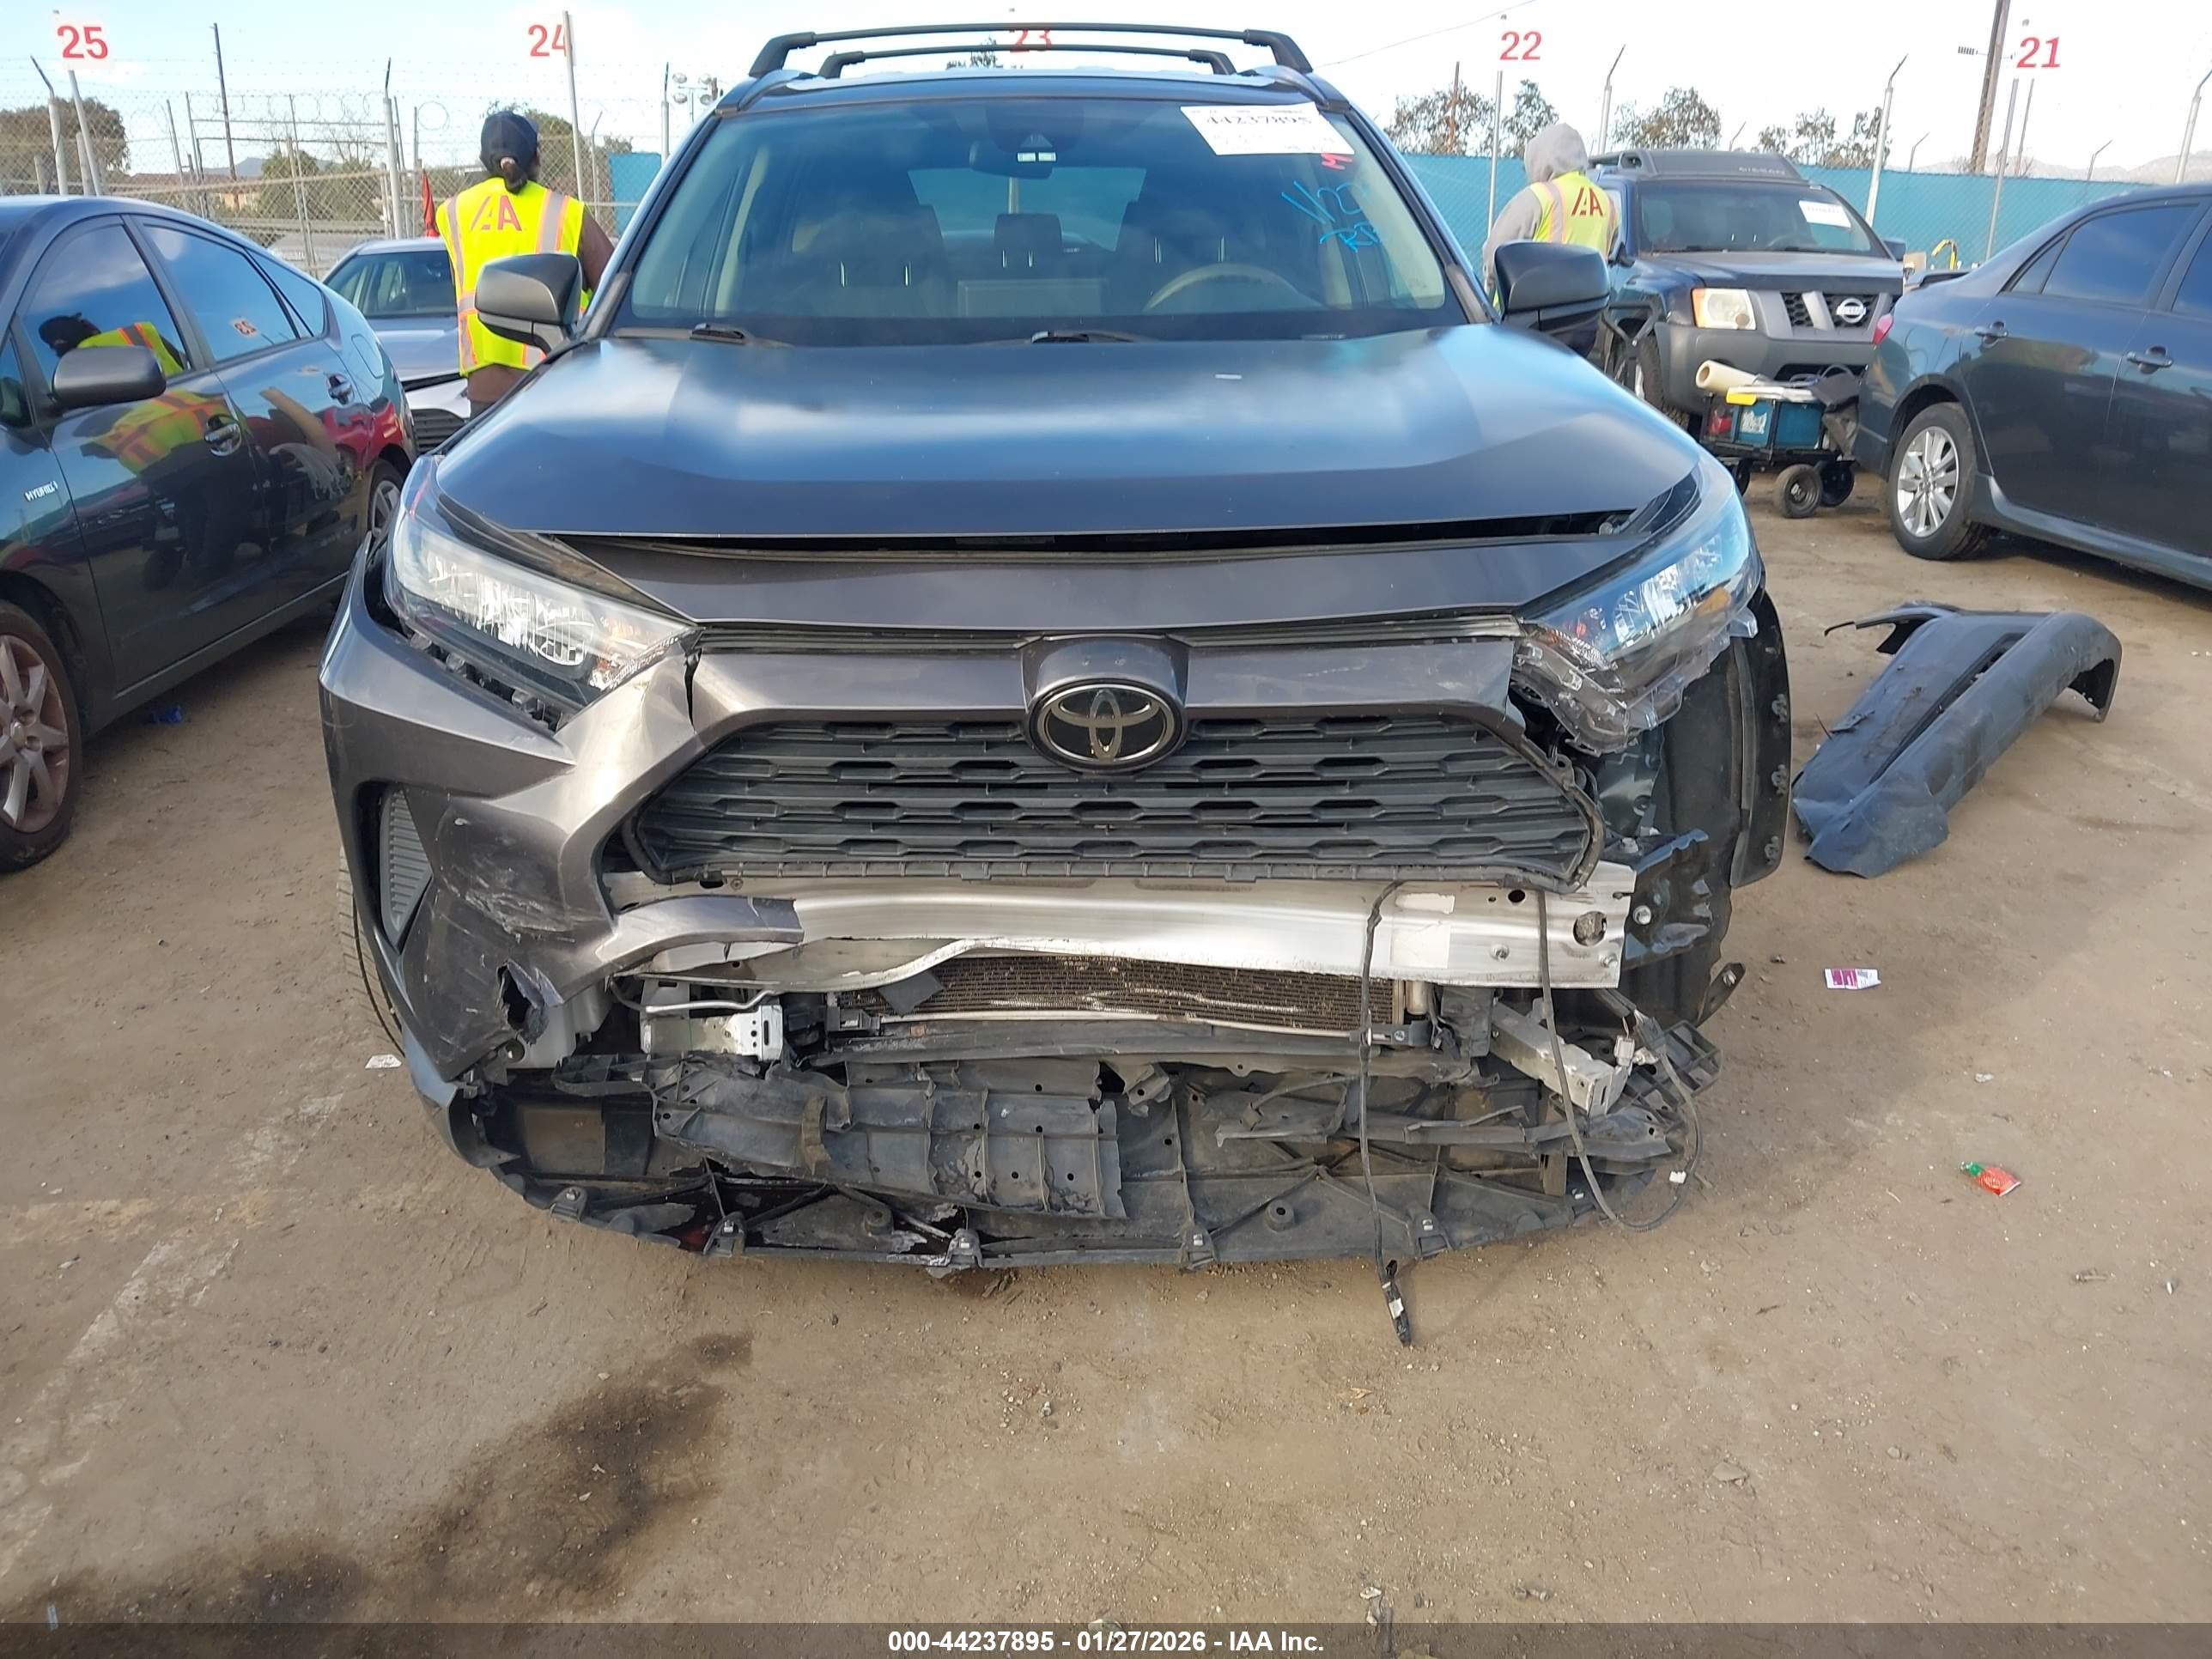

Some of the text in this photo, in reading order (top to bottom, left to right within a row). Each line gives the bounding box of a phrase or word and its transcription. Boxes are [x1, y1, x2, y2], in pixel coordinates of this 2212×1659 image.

[57, 25, 108, 59] 25
[528, 24, 567, 57] 24
[1500, 31, 1542, 60] 22
[2016, 36, 2061, 68] 21
